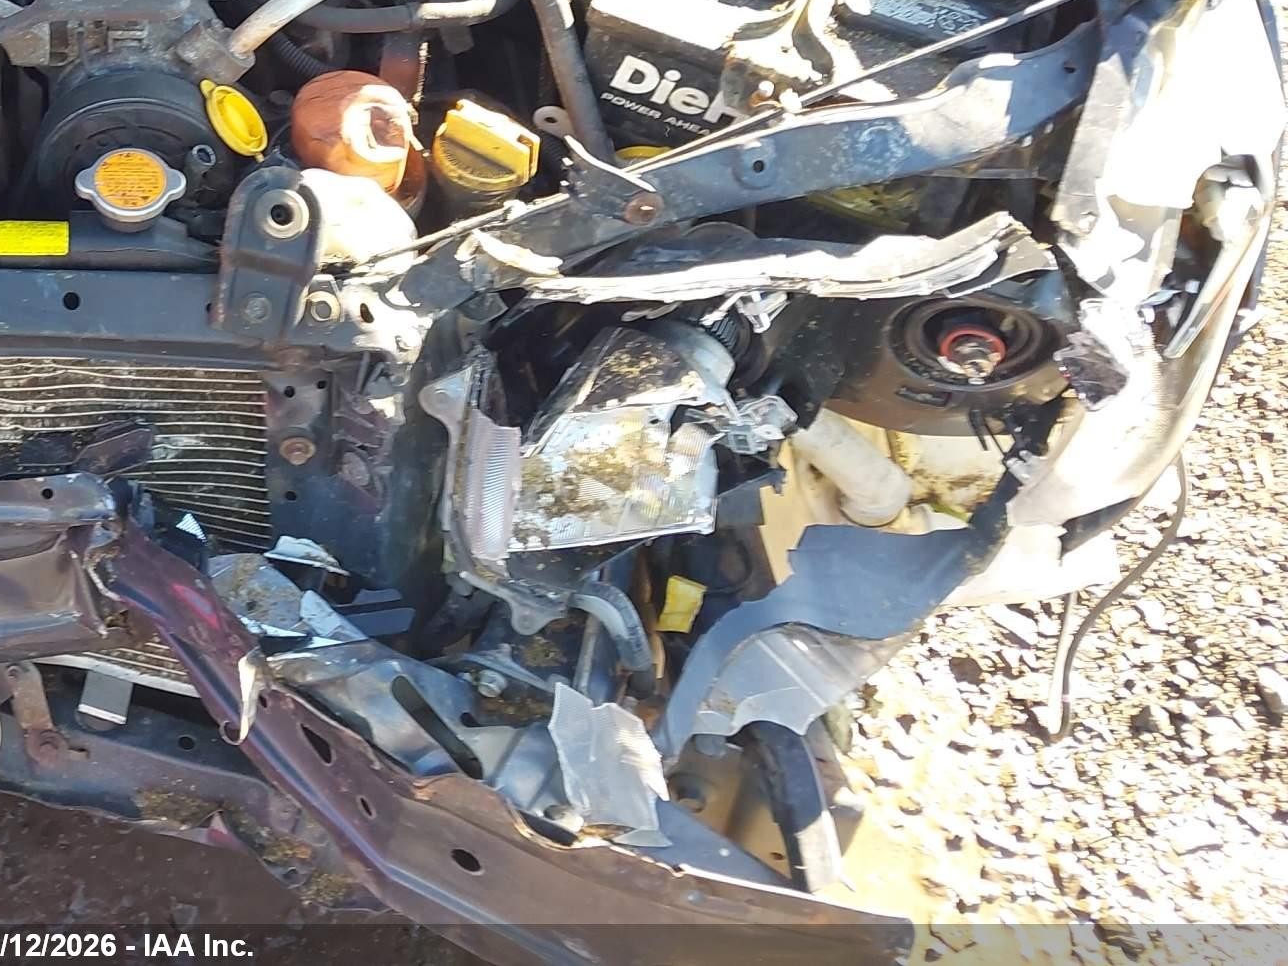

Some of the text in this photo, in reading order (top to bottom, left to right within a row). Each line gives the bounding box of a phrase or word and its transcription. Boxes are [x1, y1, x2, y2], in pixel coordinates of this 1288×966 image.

[600, 92, 711, 137] POWER AHEA
[609, 54, 751, 125] DieH
